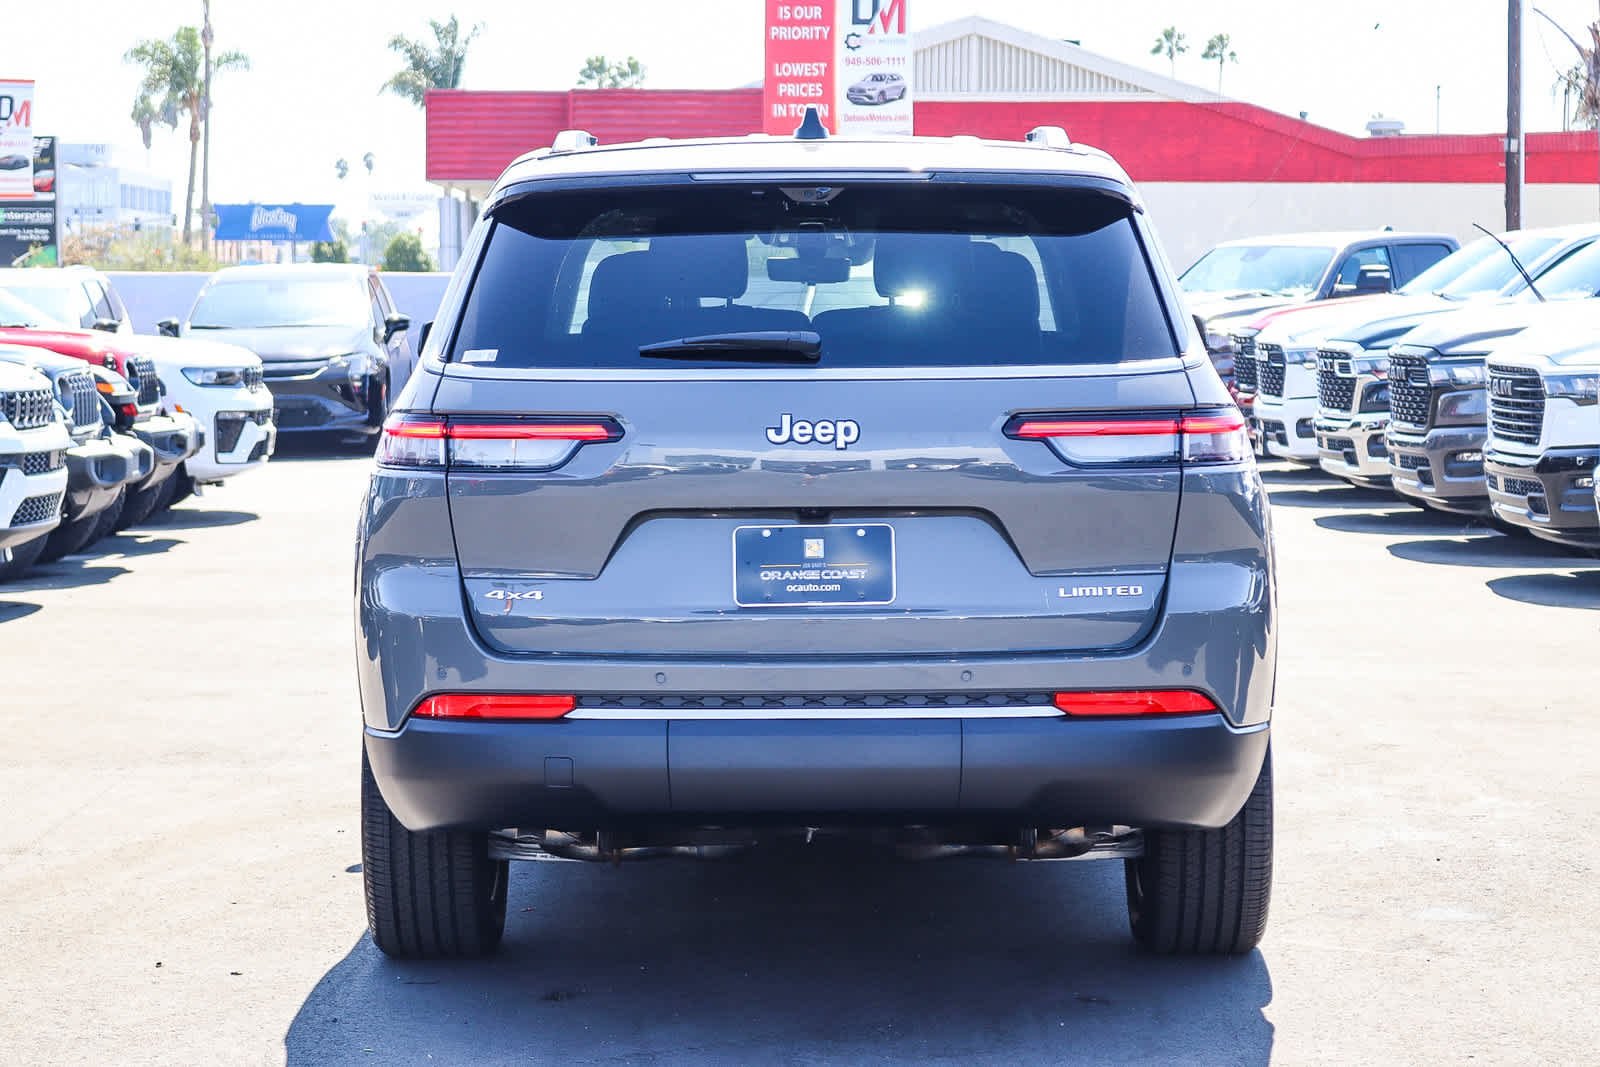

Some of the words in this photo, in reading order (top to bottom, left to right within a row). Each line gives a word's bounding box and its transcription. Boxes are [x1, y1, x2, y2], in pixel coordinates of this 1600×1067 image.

[779, 6, 791, 19] IS
[795, 6, 822, 19] OUR
[770, 27, 830, 40] PRIORITY
[775, 63, 827, 76] LOWEST
[779, 83, 823, 97] PRICES
[773, 104, 788, 117] IN
[791, 104, 828, 117] TON
[766, 413, 860, 450] Jeep
[760, 569, 820, 581] ORANGE
[821, 568, 868, 579] COAST
[484, 590, 545, 600] 4x4
[1058, 586, 1144, 597] LIMITED
[786, 584, 841, 592] ocauto.com
